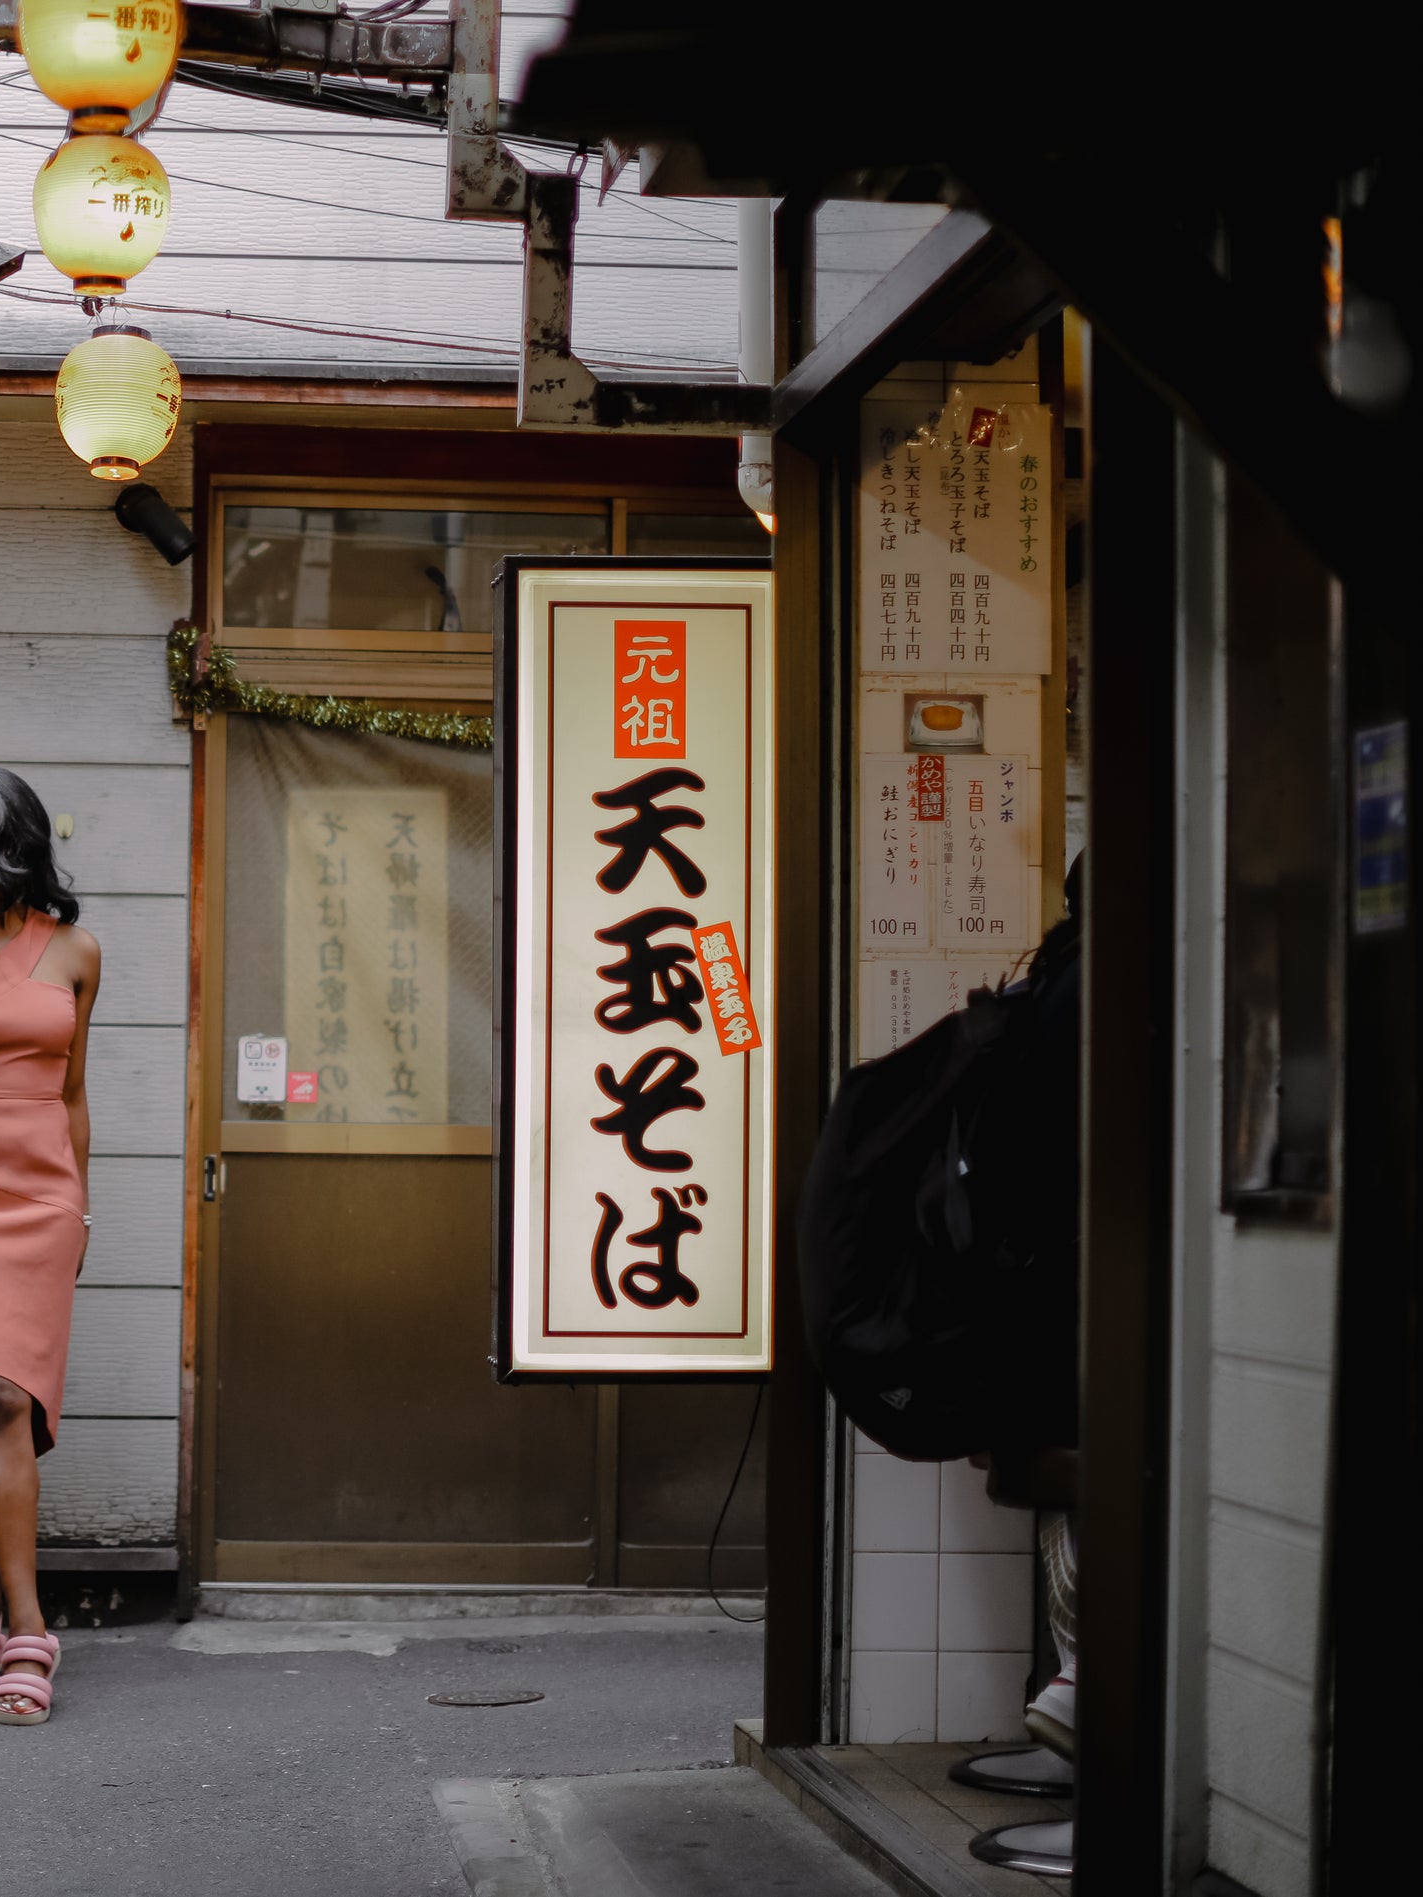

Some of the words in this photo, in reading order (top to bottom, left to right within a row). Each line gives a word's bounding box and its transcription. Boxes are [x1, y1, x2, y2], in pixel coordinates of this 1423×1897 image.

[87, 6, 174, 35] 一番搾り
[878, 426, 897, 551] 冷しきつねそば
[948, 430, 967, 554] とろろ玉子そば
[972, 449, 992, 519] 天玉そば
[1019, 453, 1039, 573] 春のおすすめ
[879, 573, 897, 662] 四百七十円
[904, 573, 922, 661] 四百九十円
[949, 573, 967, 661] 四百四十円
[973, 575, 992, 663] 四百九十円
[620, 633, 681, 749] 元祖
[920, 756, 943, 818] かめや謹製
[999, 761, 1015, 823] ジャンボ
[880, 784, 899, 885] 鮭おにぎり
[967, 779, 987, 915] 五目いなり寿司
[589, 765, 708, 1312] 天玉そば
